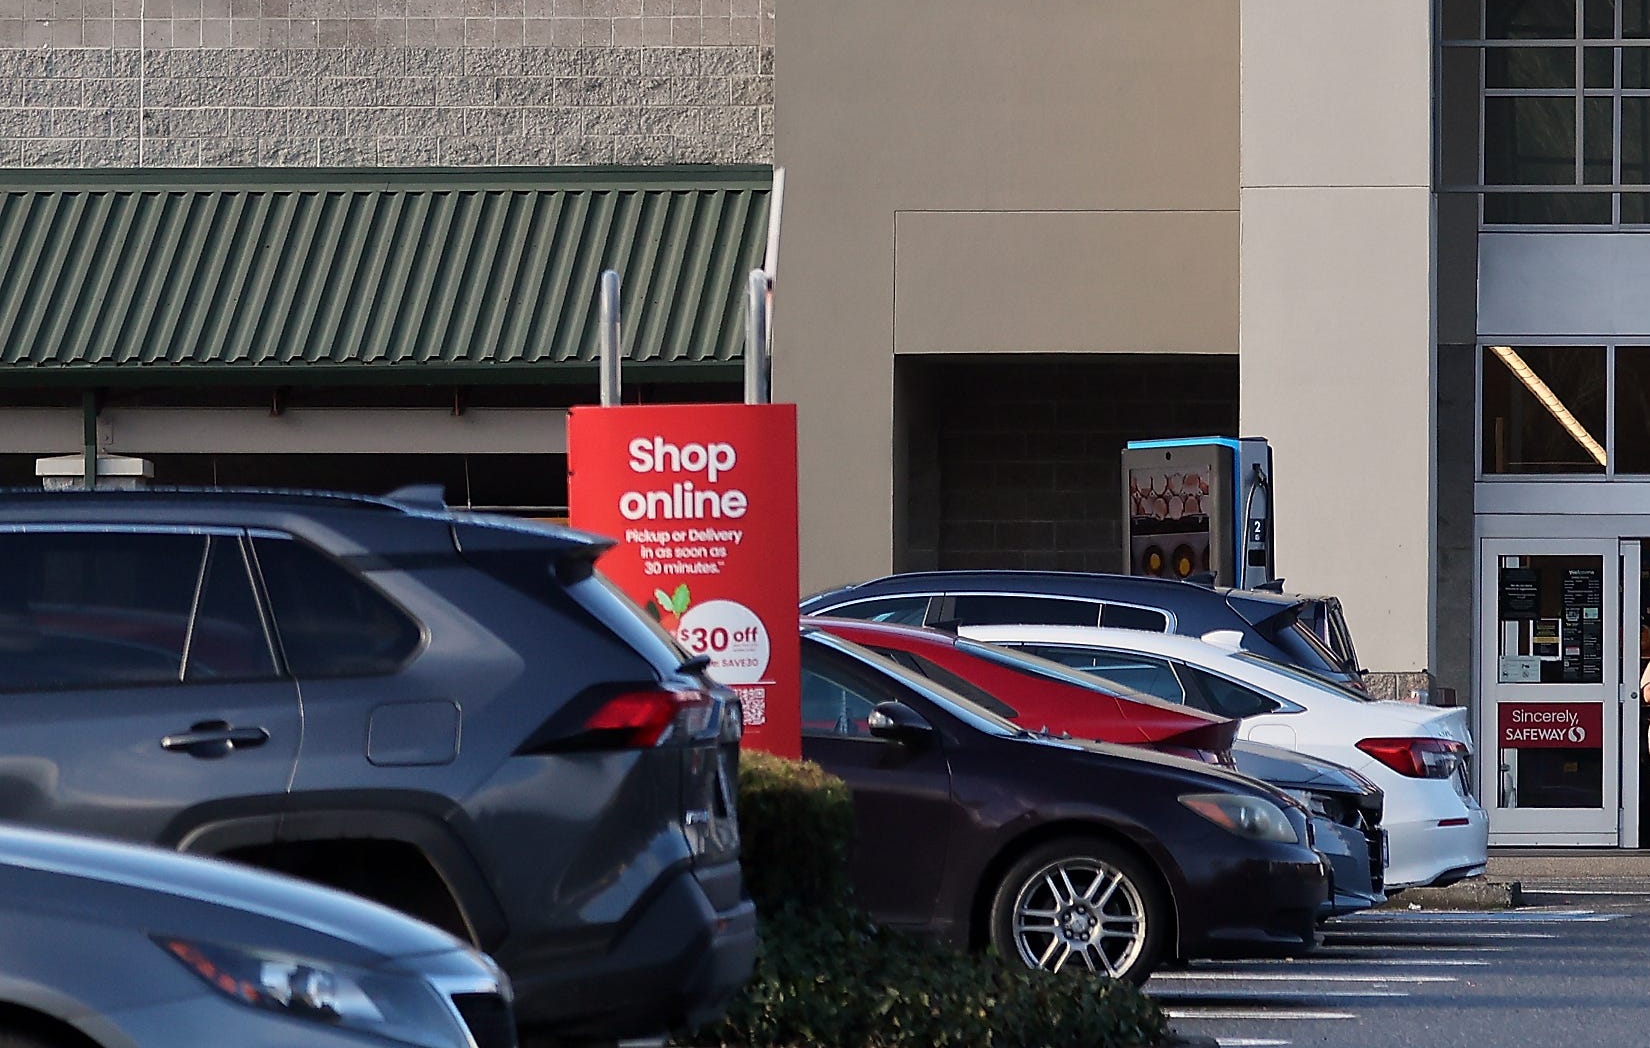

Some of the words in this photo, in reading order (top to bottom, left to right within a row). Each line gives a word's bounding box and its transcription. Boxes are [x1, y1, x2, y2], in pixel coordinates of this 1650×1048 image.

[628, 435, 737, 483] Shop
[619, 481, 748, 520] online
[1254, 520, 1262, 533] 2
[625, 528, 671, 546] Pickup
[671, 531, 687, 542] or
[688, 527, 743, 545] Delivery
[640, 544, 654, 559] in
[655, 547, 673, 559] as
[674, 546, 708, 558] soon
[709, 546, 728, 558] as
[644, 560, 662, 575] 30
[680, 626, 729, 653] $30
[733, 626, 758, 642] off
[722, 658, 759, 668] SAVE30
[1512, 709, 1579, 726] Sincerely,
[1505, 728, 1567, 741] SAFEWAY
